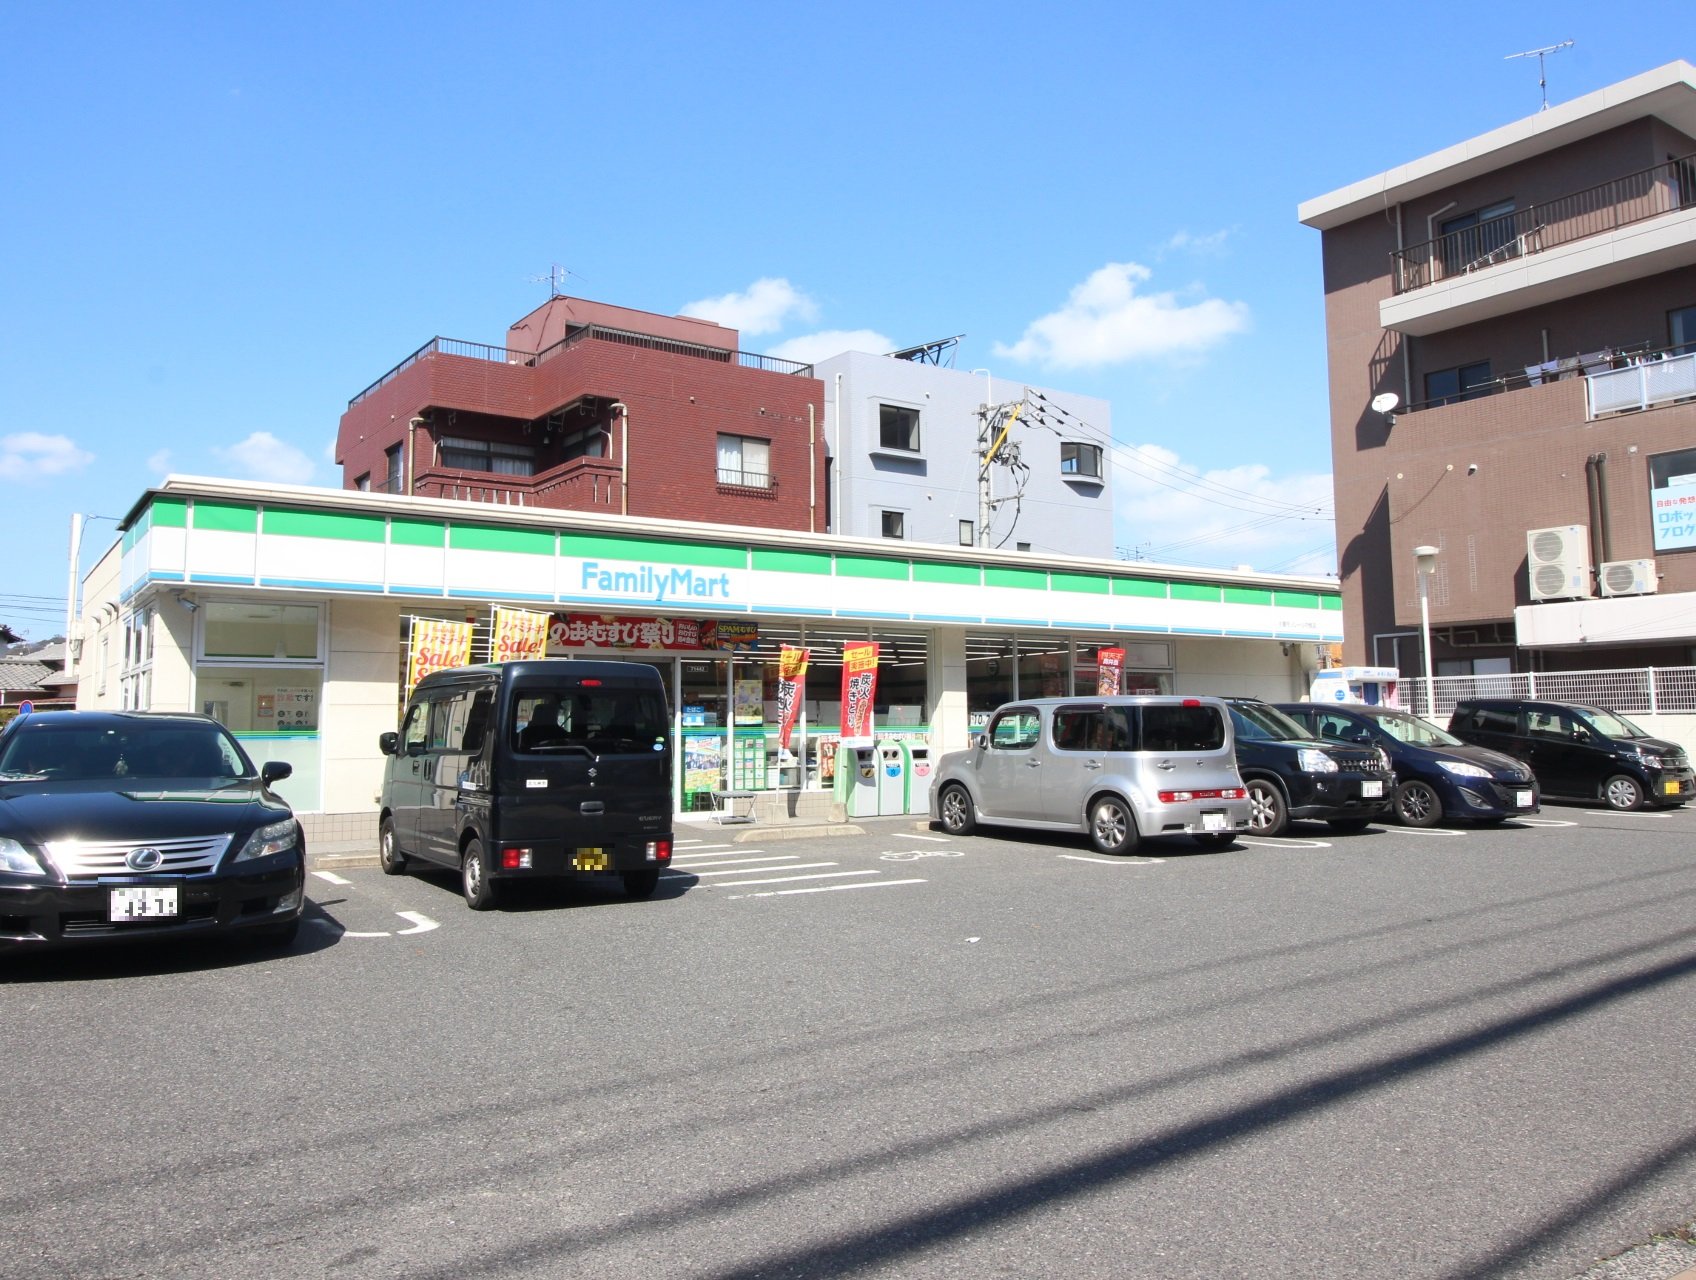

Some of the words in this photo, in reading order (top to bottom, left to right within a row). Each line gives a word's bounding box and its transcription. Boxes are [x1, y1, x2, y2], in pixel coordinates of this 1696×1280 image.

[1656, 496, 1696, 508] 自由な発想
[1658, 511, 1693, 523] ロボッ
[582, 562, 729, 601] FamilyMart
[502, 621, 545, 635] ファミチキ
[550, 620, 675, 645] のおむすび祭り
[420, 634, 468, 646] ファミチキ
[498, 635, 543, 653] Sale!
[416, 647, 466, 667] Sale!
[851, 649, 870, 659] セール
[859, 673, 872, 700] 炭火
[848, 677, 860, 728] 焼きとり
